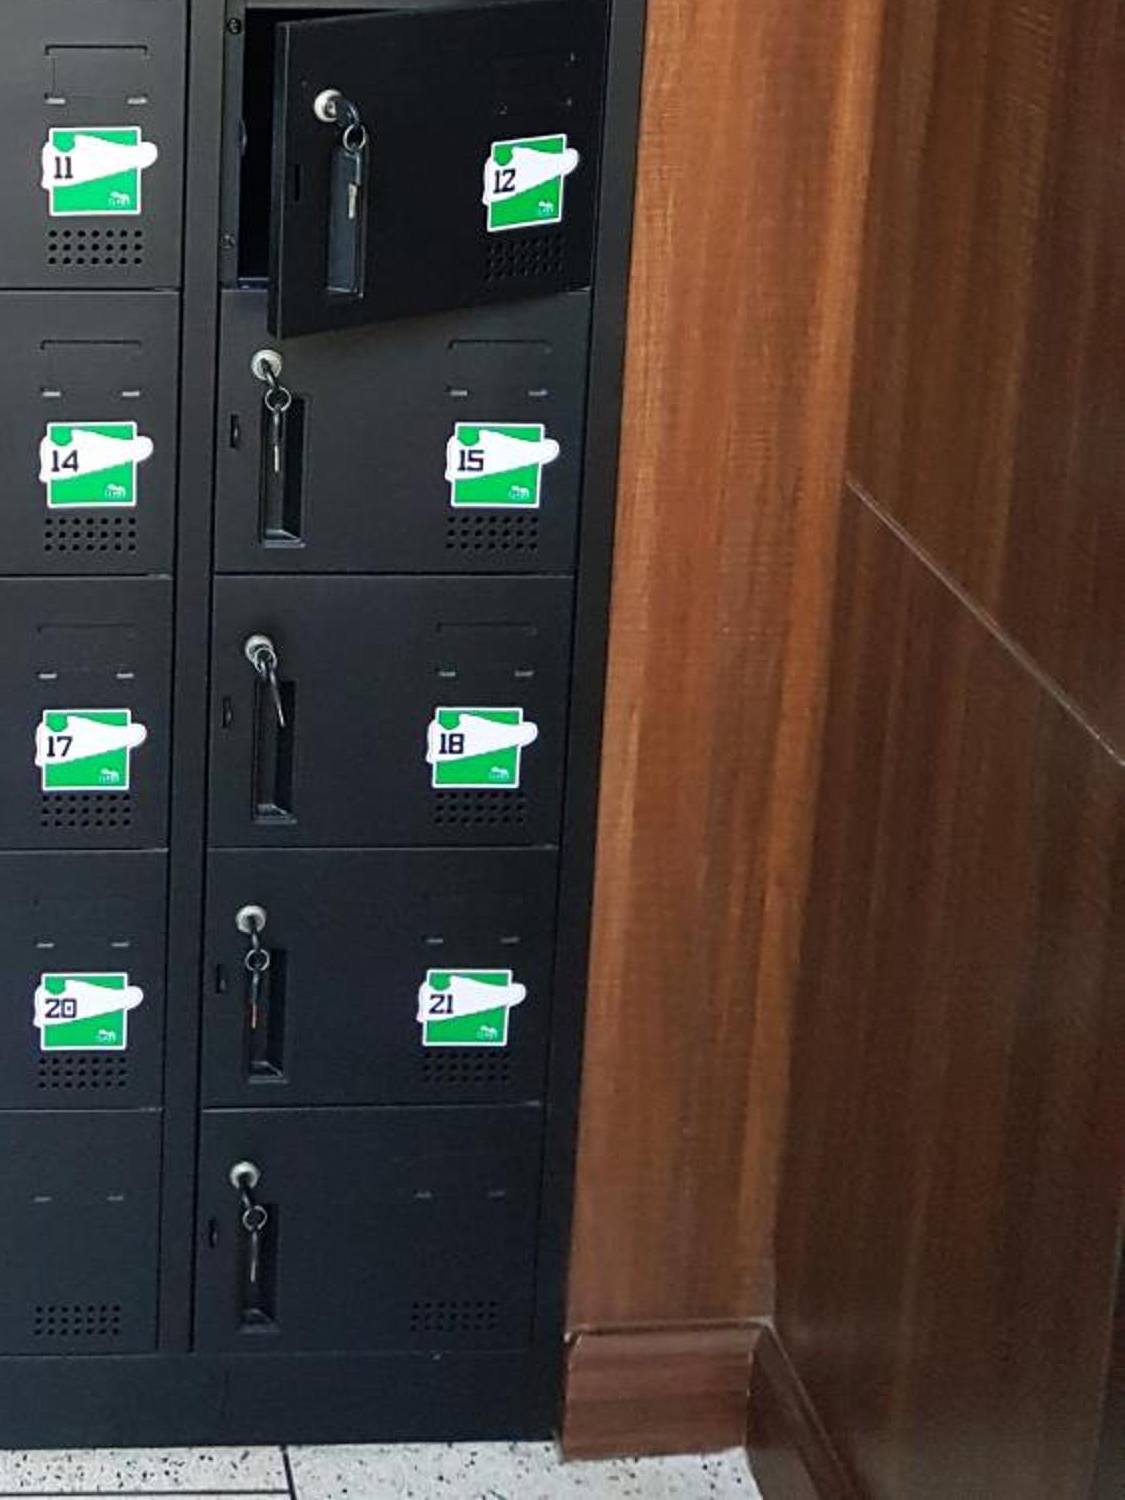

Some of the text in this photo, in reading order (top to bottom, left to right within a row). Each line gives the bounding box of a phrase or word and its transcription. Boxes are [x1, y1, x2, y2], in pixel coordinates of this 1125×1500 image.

[53, 156, 73, 180] 11
[493, 168, 516, 194] 12
[51, 449, 79, 473] 14
[457, 449, 485, 472] 15
[46, 735, 73, 758] 17
[438, 733, 465, 755] 18
[44, 998, 77, 1019] 20
[428, 993, 454, 1015] 21
